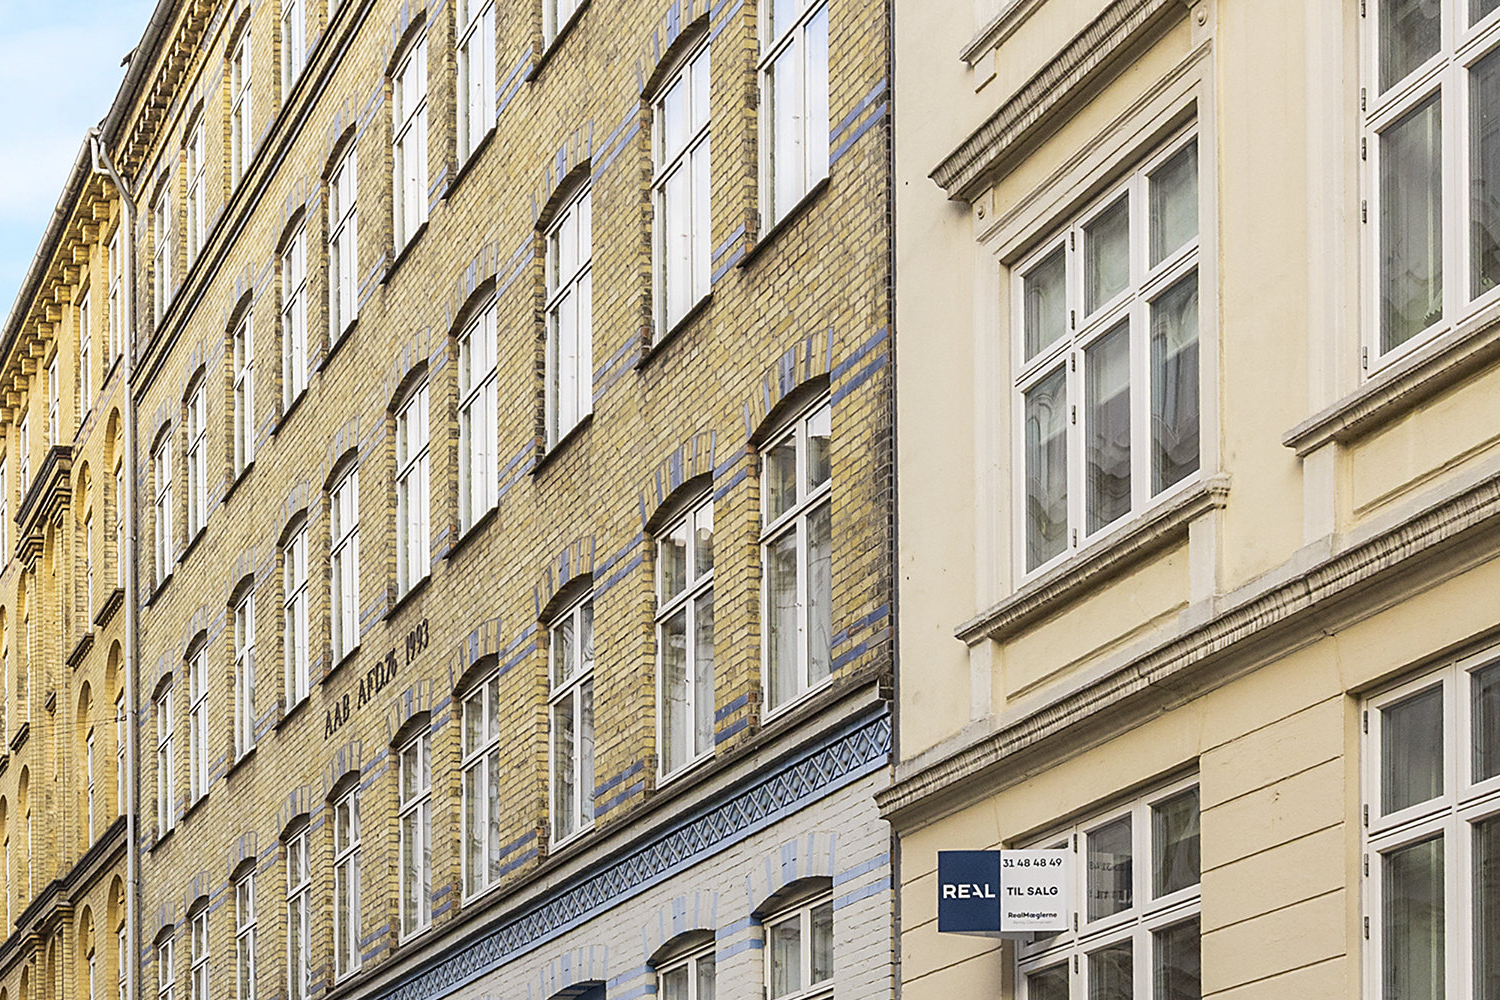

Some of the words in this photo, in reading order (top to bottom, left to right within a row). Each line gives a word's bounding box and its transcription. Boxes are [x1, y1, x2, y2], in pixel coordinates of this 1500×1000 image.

[324, 693, 350, 740] AAB
[406, 618, 429, 666] 1993
[1003, 859, 1014, 868] 31
[1017, 858, 1031, 867] 48
[1033, 858, 1047, 867] 48
[1049, 858, 1062, 867] 49
[943, 884, 996, 899] REAL
[1006, 887, 1024, 896] TIL
[1027, 886, 1058, 896] SALG
[1007, 912, 1057, 920] RealMæglerne
